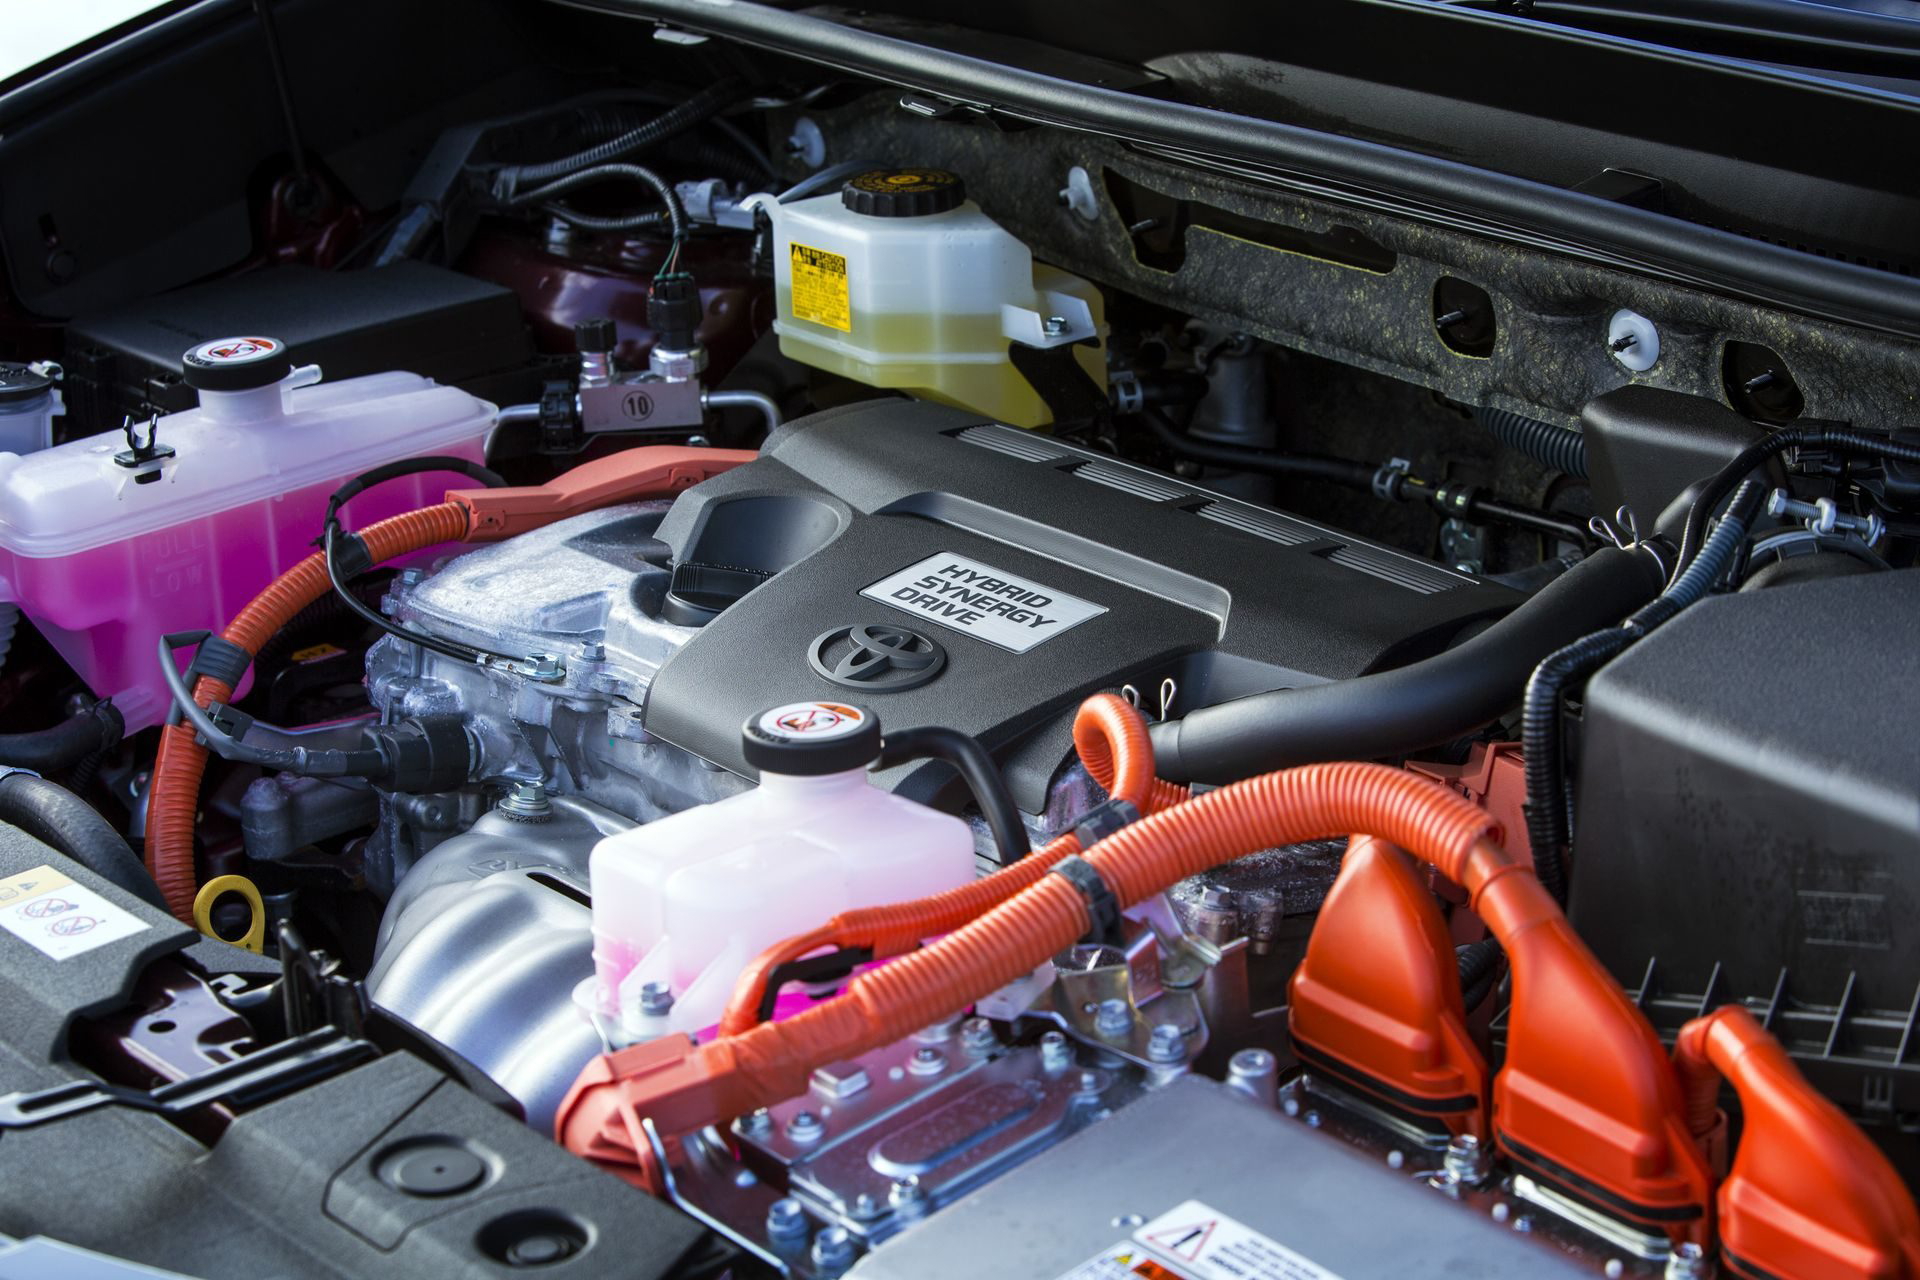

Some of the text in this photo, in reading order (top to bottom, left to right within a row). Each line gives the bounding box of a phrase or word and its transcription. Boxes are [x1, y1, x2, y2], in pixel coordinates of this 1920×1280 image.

[628, 396, 649, 416] 10
[141, 527, 206, 566] FULL
[149, 561, 205, 598] LOW
[938, 564, 1053, 609] HYBRID
[890, 587, 985, 626] DRIVE
[913, 575, 1057, 628] SYNERGY
